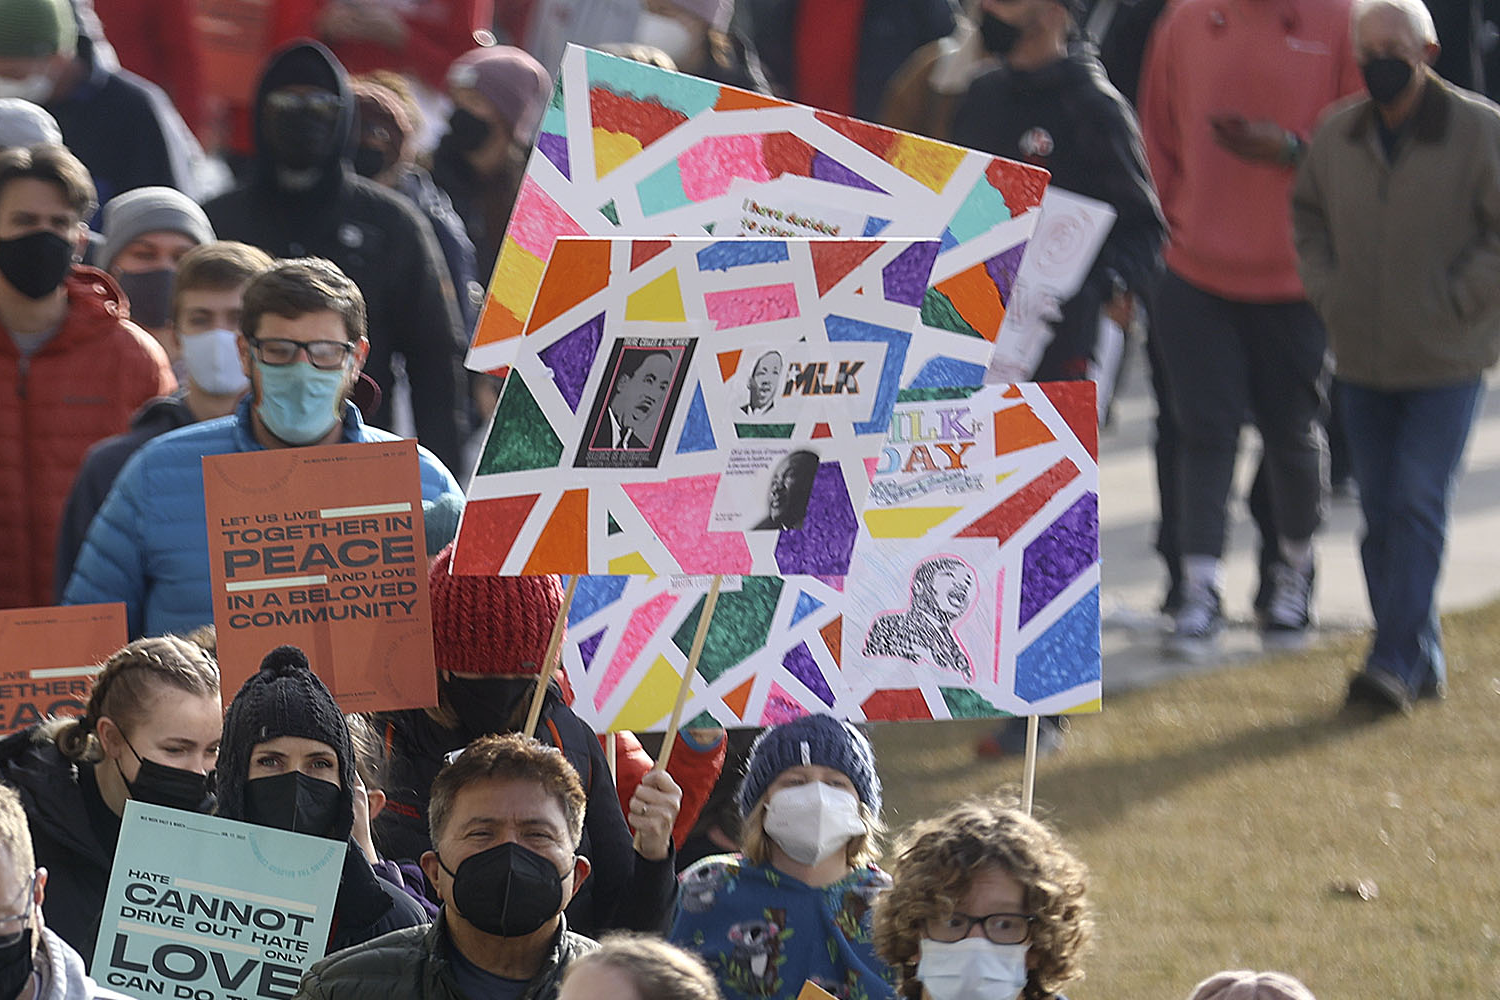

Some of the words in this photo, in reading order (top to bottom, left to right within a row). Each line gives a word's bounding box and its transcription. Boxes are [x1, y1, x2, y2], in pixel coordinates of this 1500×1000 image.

[783, 360, 865, 397] MLK
[220, 516, 249, 527] LET
[255, 513, 278, 523] US
[284, 510, 318, 522] LIVE
[222, 519, 379, 545] TOGETHER
[385, 516, 412, 532] IN
[223, 535, 415, 578] PEACE
[330, 571, 366, 584] AND
[371, 568, 416, 580] LOVE
[227, 594, 254, 610] IN
[262, 593, 282, 606] A
[288, 582, 417, 605] BELOVED
[229, 600, 417, 629] COMMUNITY
[128, 869, 170, 885] HATE
[124, 883, 314, 937] CANNOT
[120, 906, 185, 929] DRIVE
[195, 921, 242, 940] OUT
[251, 931, 309, 953] HATE
[109, 932, 303, 1000] LOVE
[265, 950, 305, 965] ONLY
[107, 972, 165, 994] CAN
